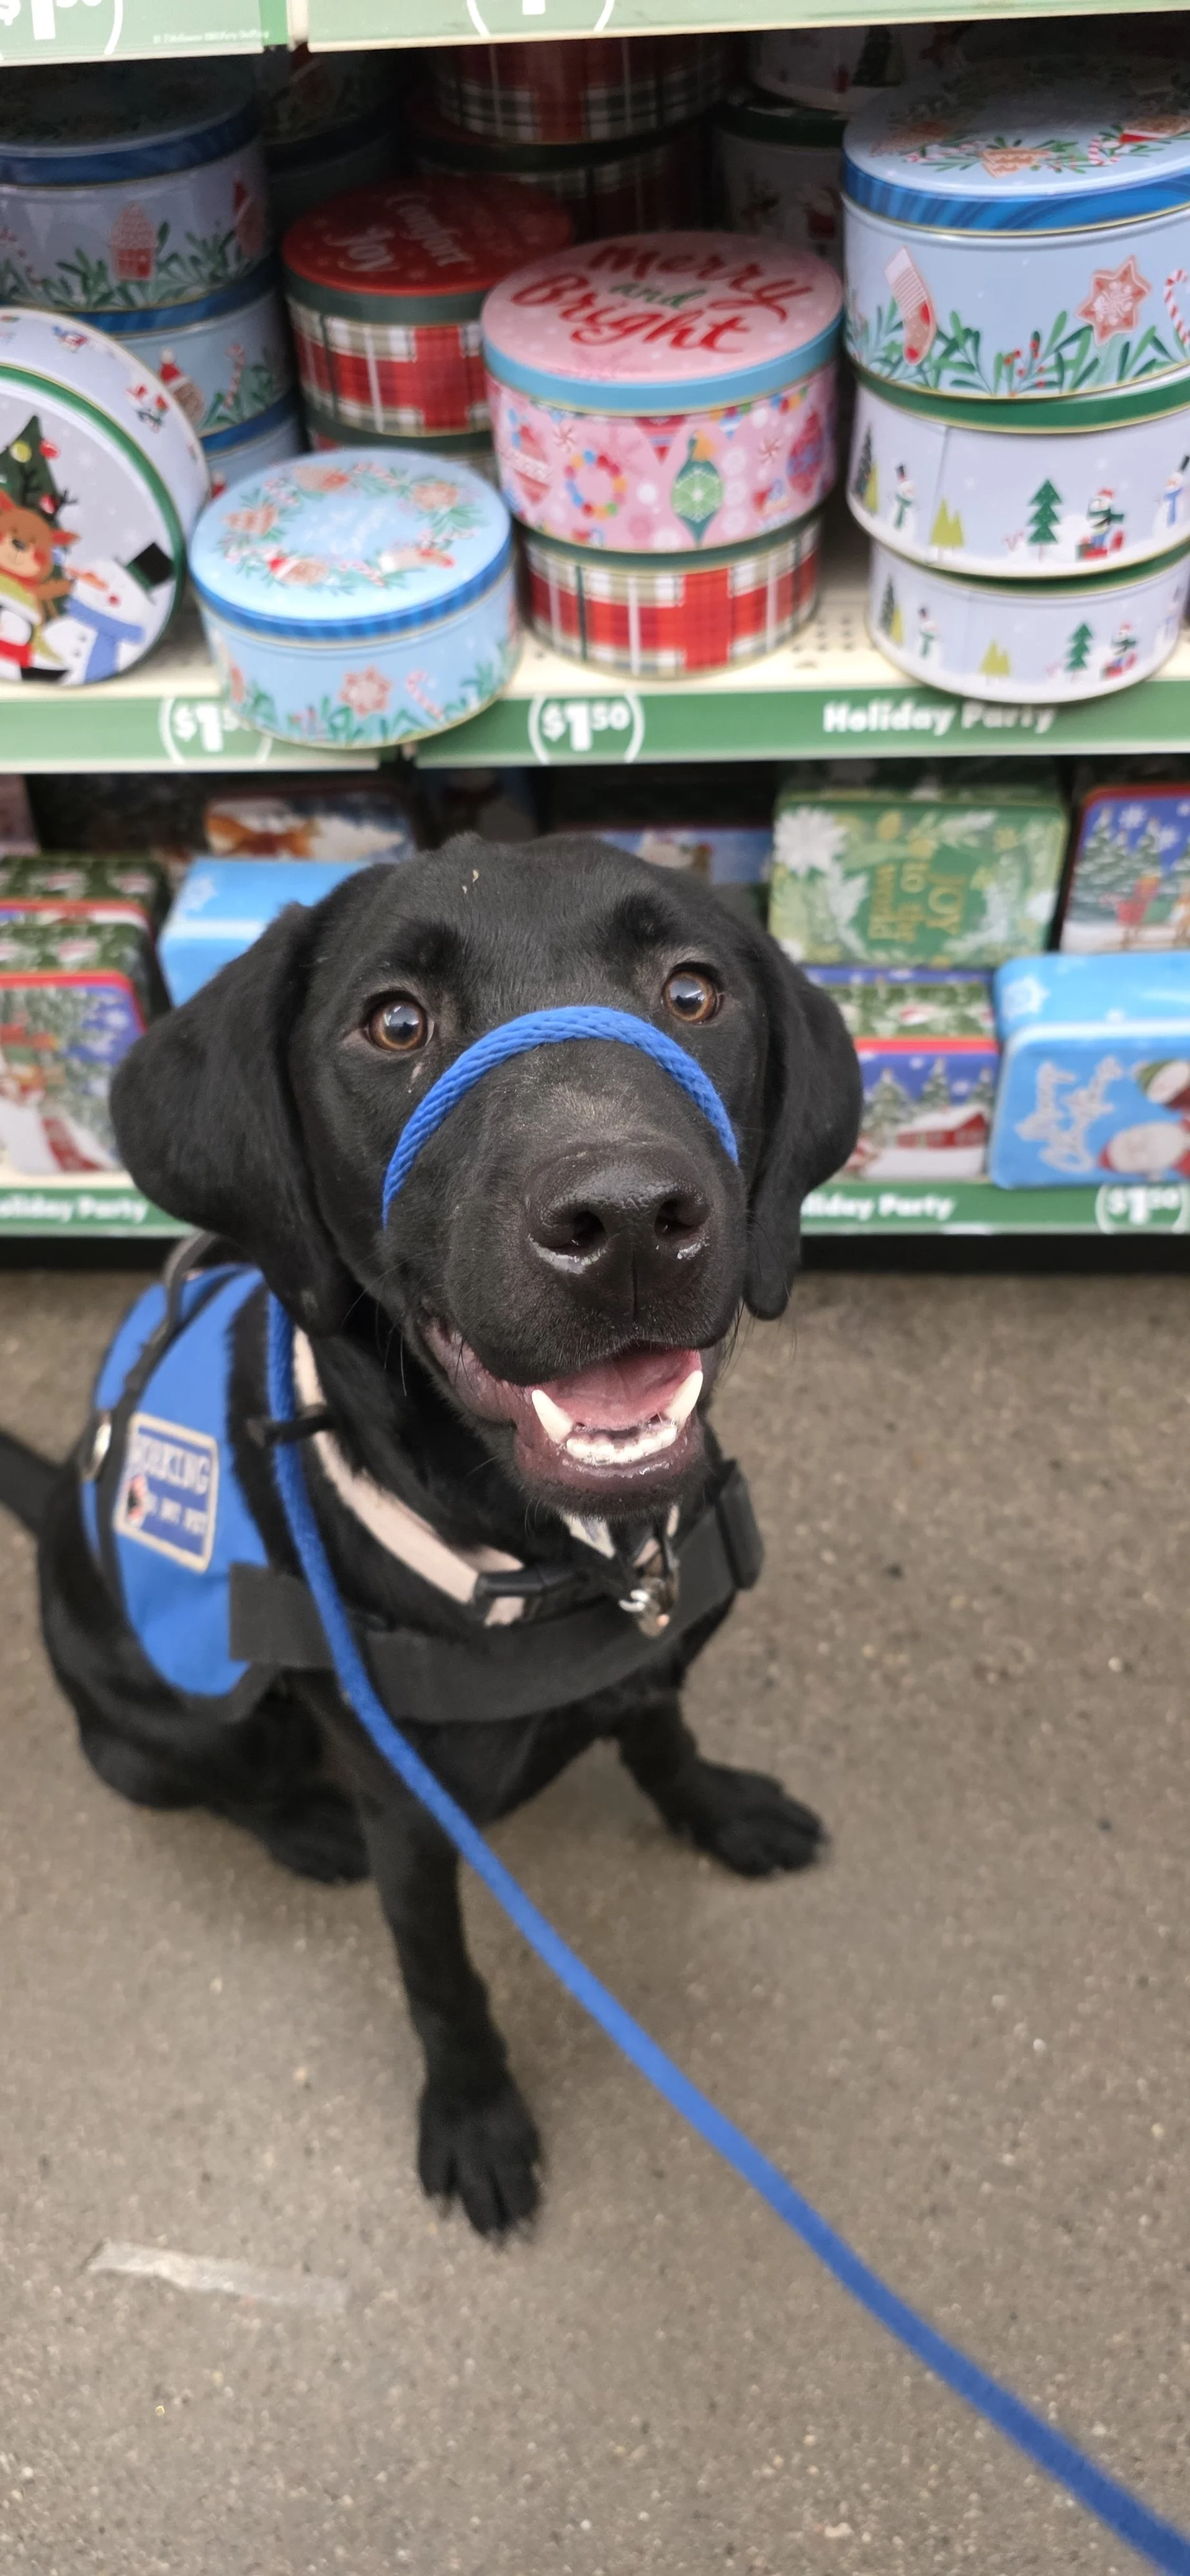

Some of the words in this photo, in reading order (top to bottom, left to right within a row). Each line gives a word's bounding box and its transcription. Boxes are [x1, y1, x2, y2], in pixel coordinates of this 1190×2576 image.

[587, 245, 813, 323] Merry
[609, 283, 708, 309] and
[511, 273, 752, 354] Bright
[823, 697, 956, 737] Holiday
[961, 700, 1054, 734] Party
[0, 1193, 73, 1222] oliday
[77, 1193, 149, 1224] Party
[878, 1193, 956, 1221] Party
